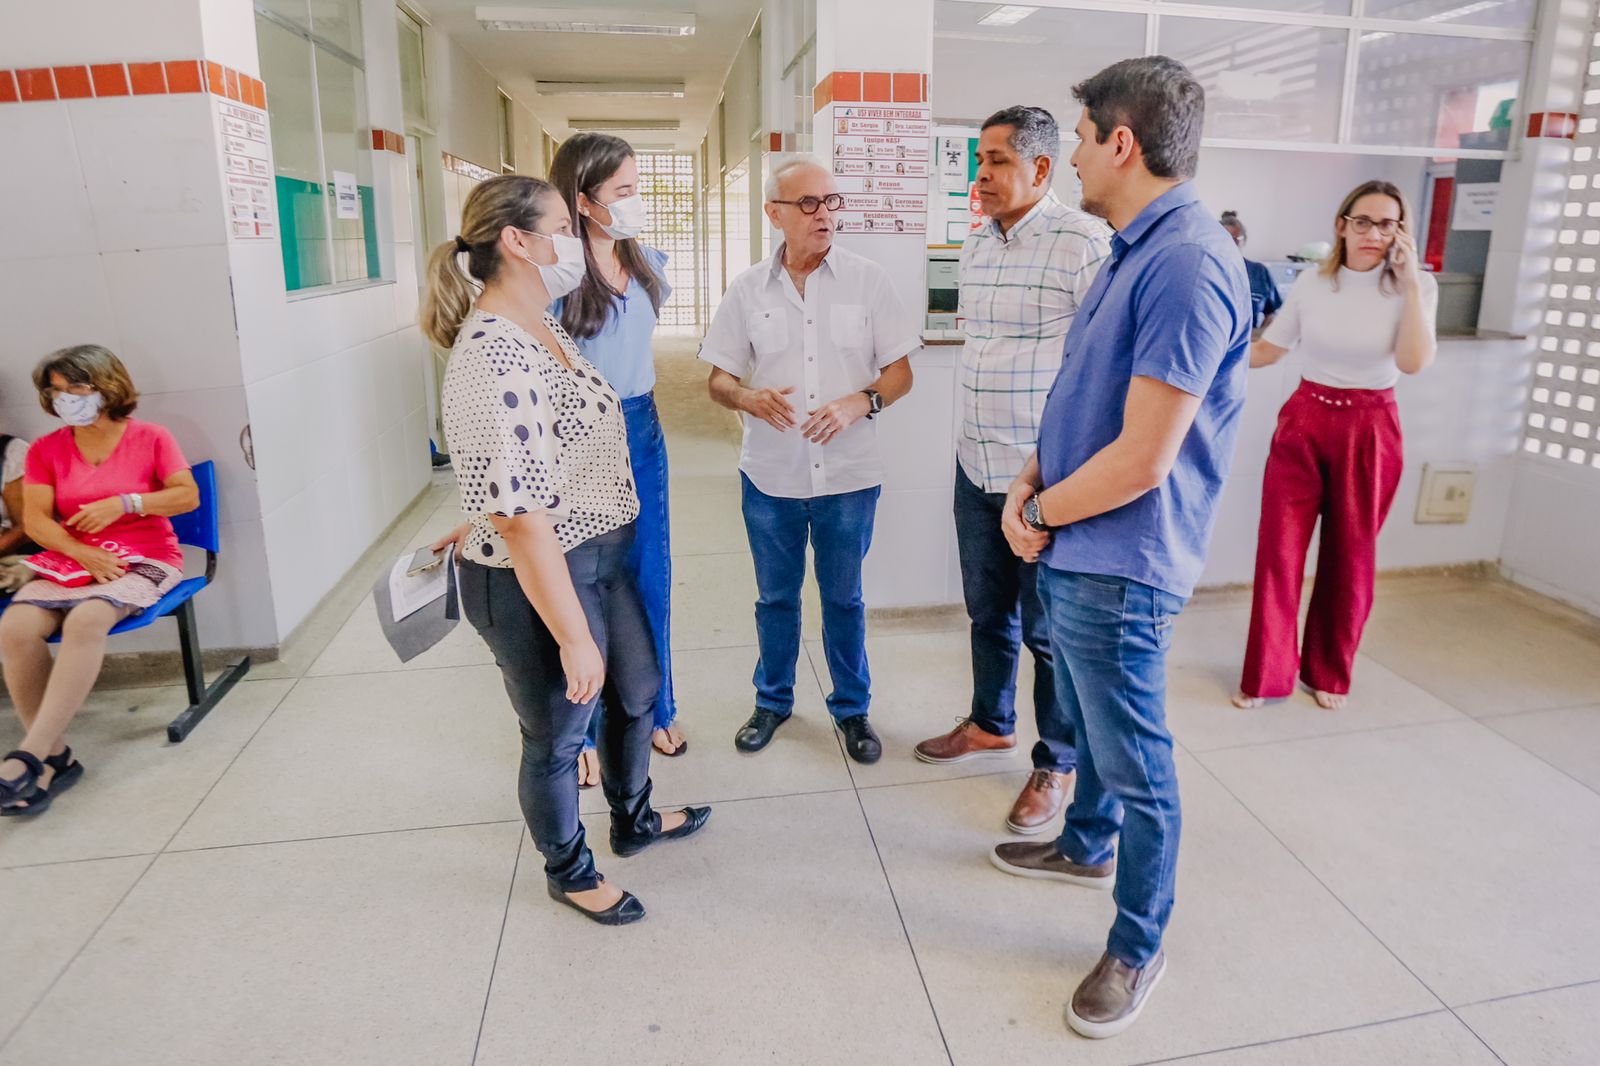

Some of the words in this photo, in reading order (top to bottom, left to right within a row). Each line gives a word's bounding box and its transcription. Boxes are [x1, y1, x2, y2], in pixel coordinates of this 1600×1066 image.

[868, 109, 882, 118] VIVER
[883, 110, 894, 118] BEM
[894, 110, 922, 119] INTEGRADA
